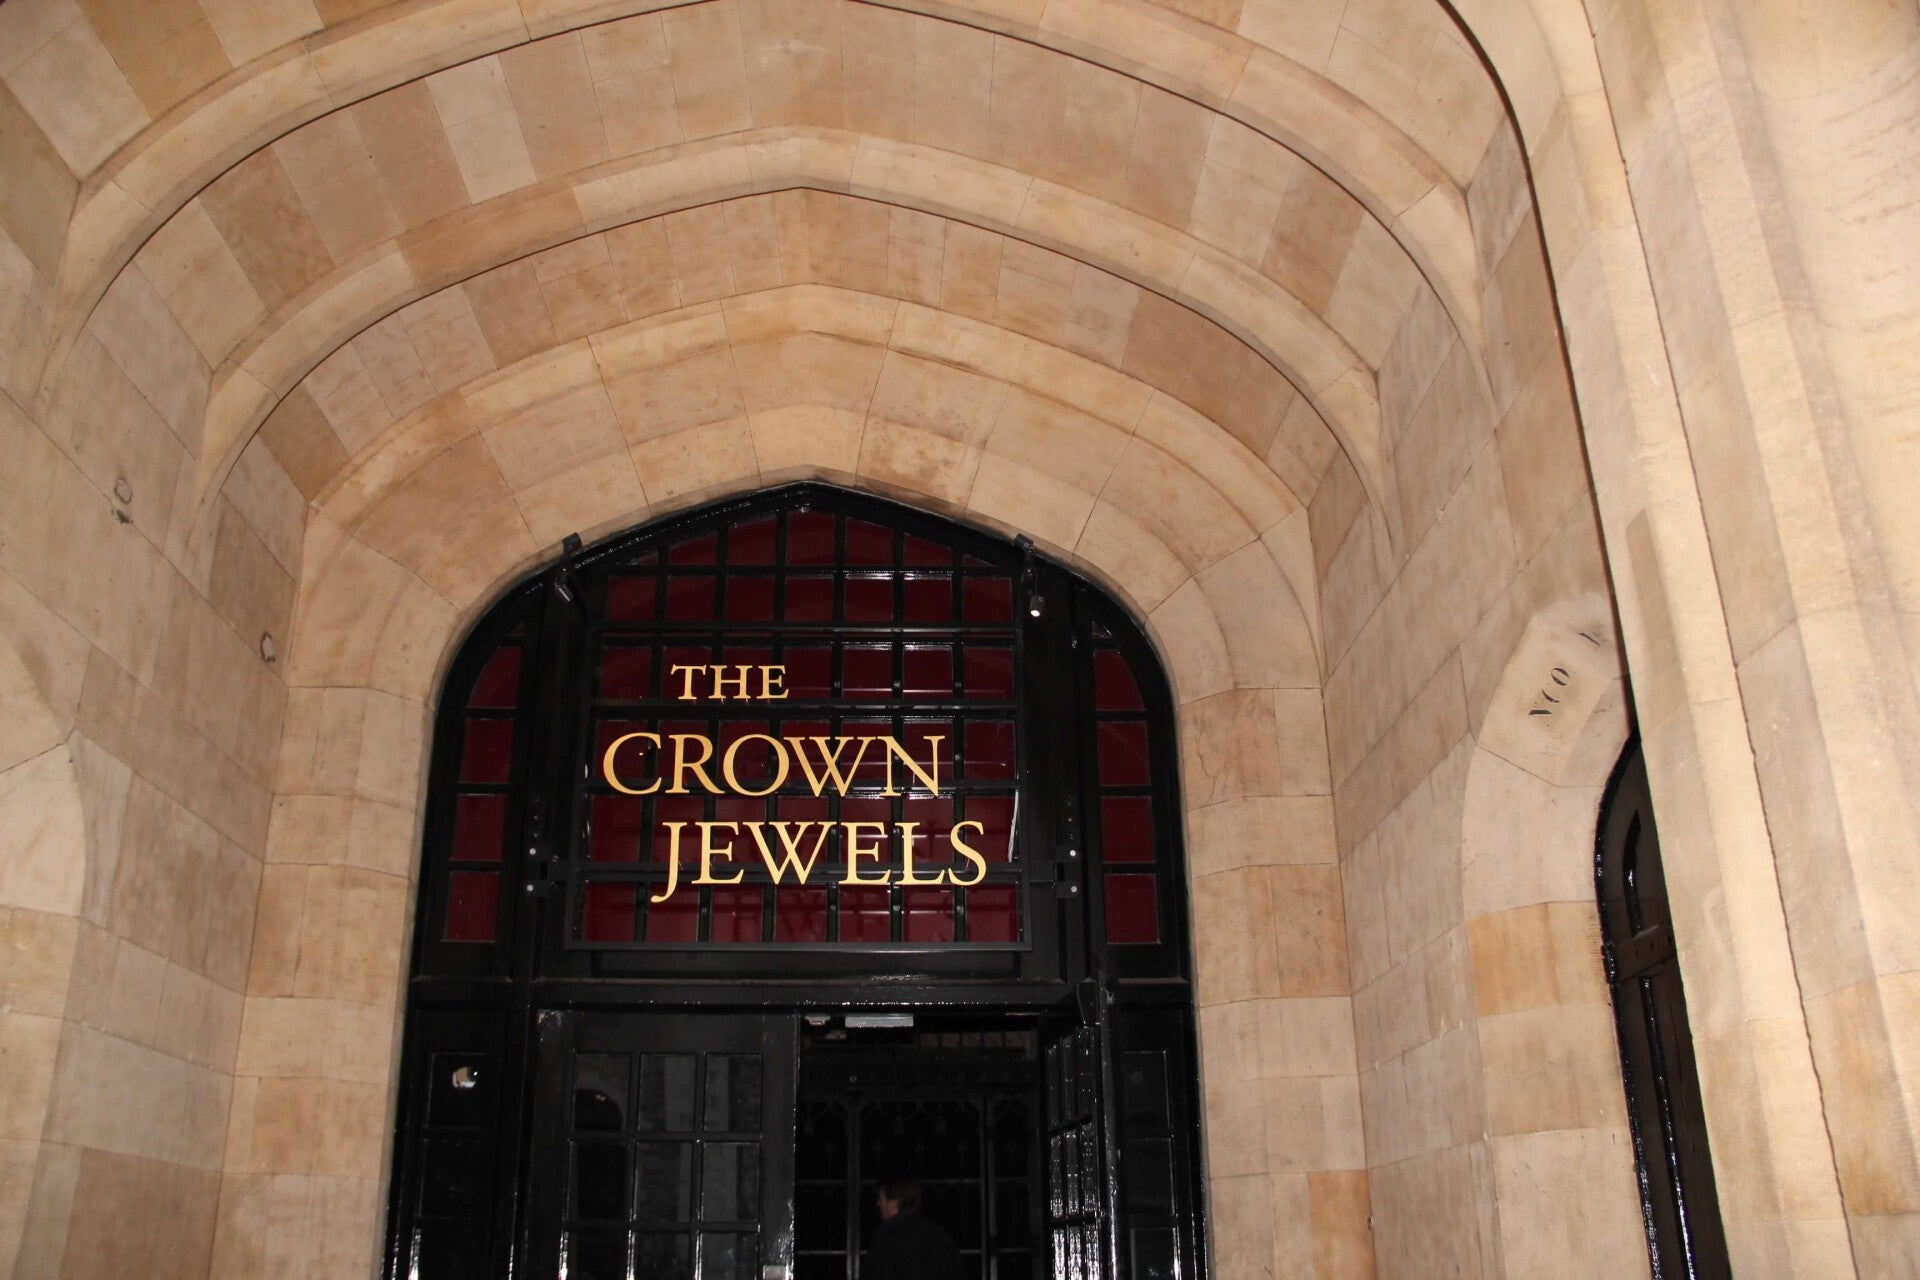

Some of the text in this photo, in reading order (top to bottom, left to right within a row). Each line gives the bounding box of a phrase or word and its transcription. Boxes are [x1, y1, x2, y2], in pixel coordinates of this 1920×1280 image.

[670, 663, 789, 700] THE
[602, 732, 946, 798] CROWN
[650, 820, 987, 903] JEWELS
